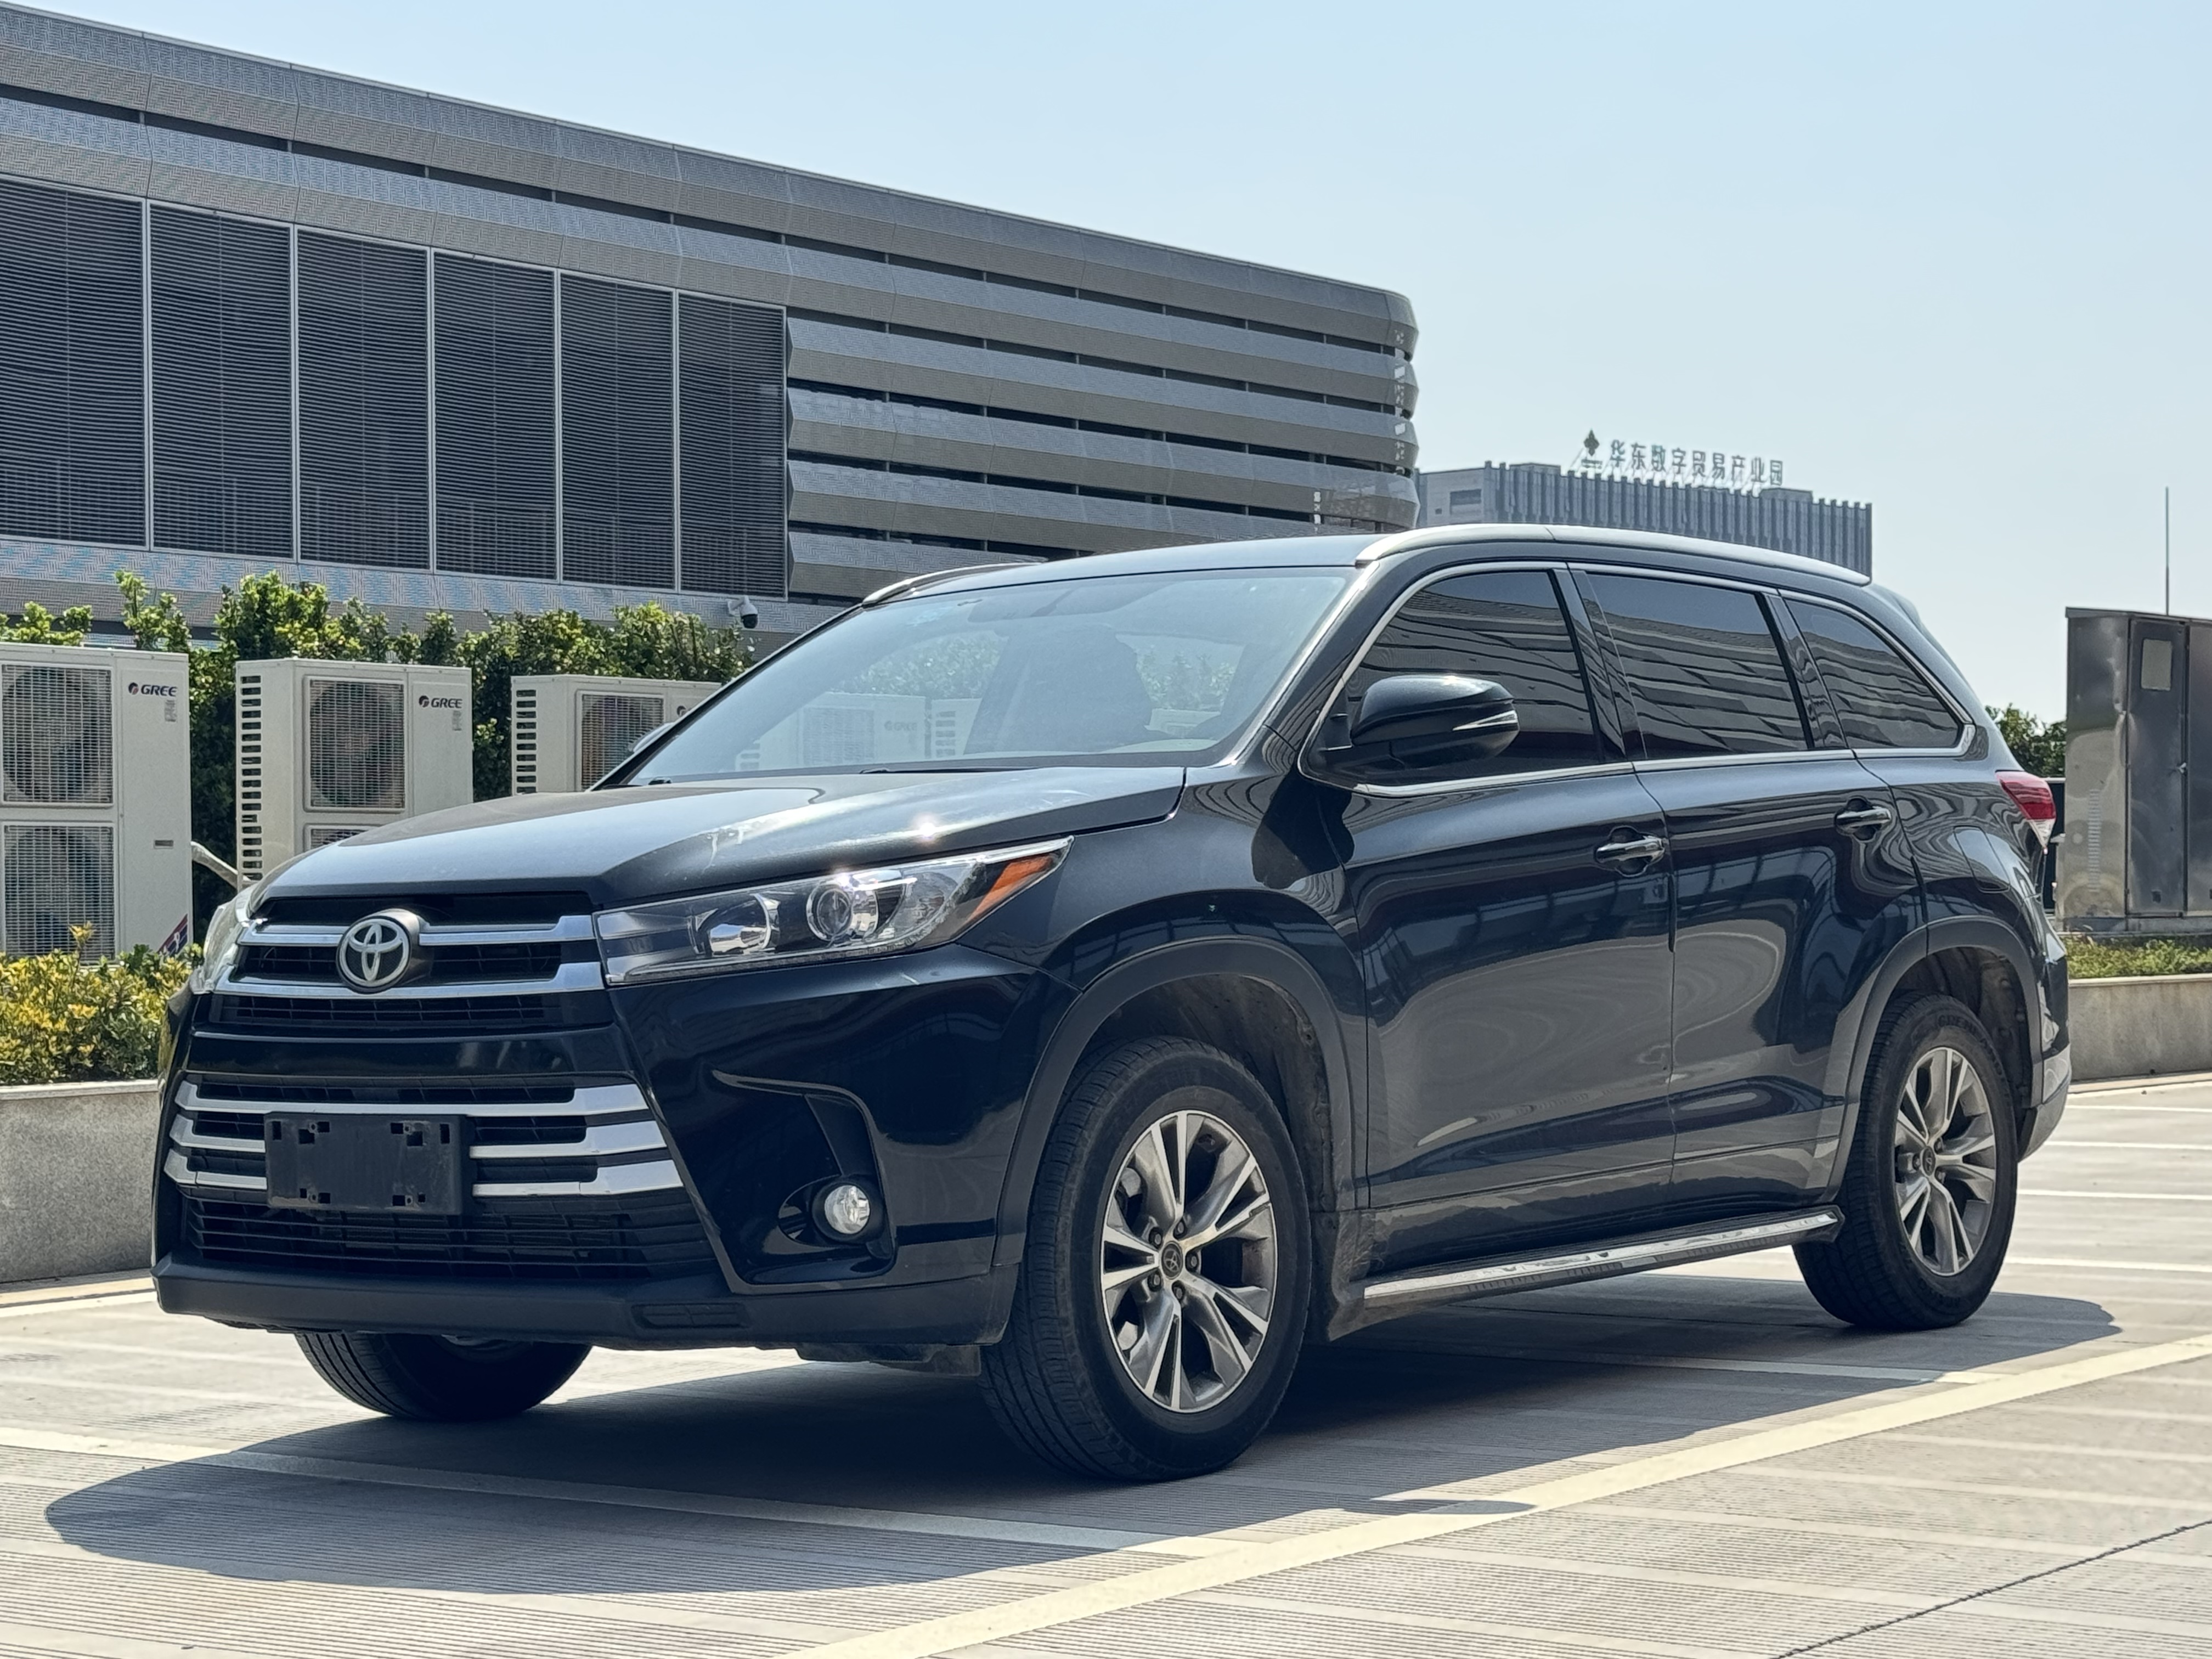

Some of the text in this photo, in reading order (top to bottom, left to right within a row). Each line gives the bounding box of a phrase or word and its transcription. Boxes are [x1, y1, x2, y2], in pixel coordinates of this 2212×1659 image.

[1610, 439, 1783, 486] 华东数字贸易产业园
[141, 684, 178, 697] GREE
[431, 697, 462, 709] GREE
